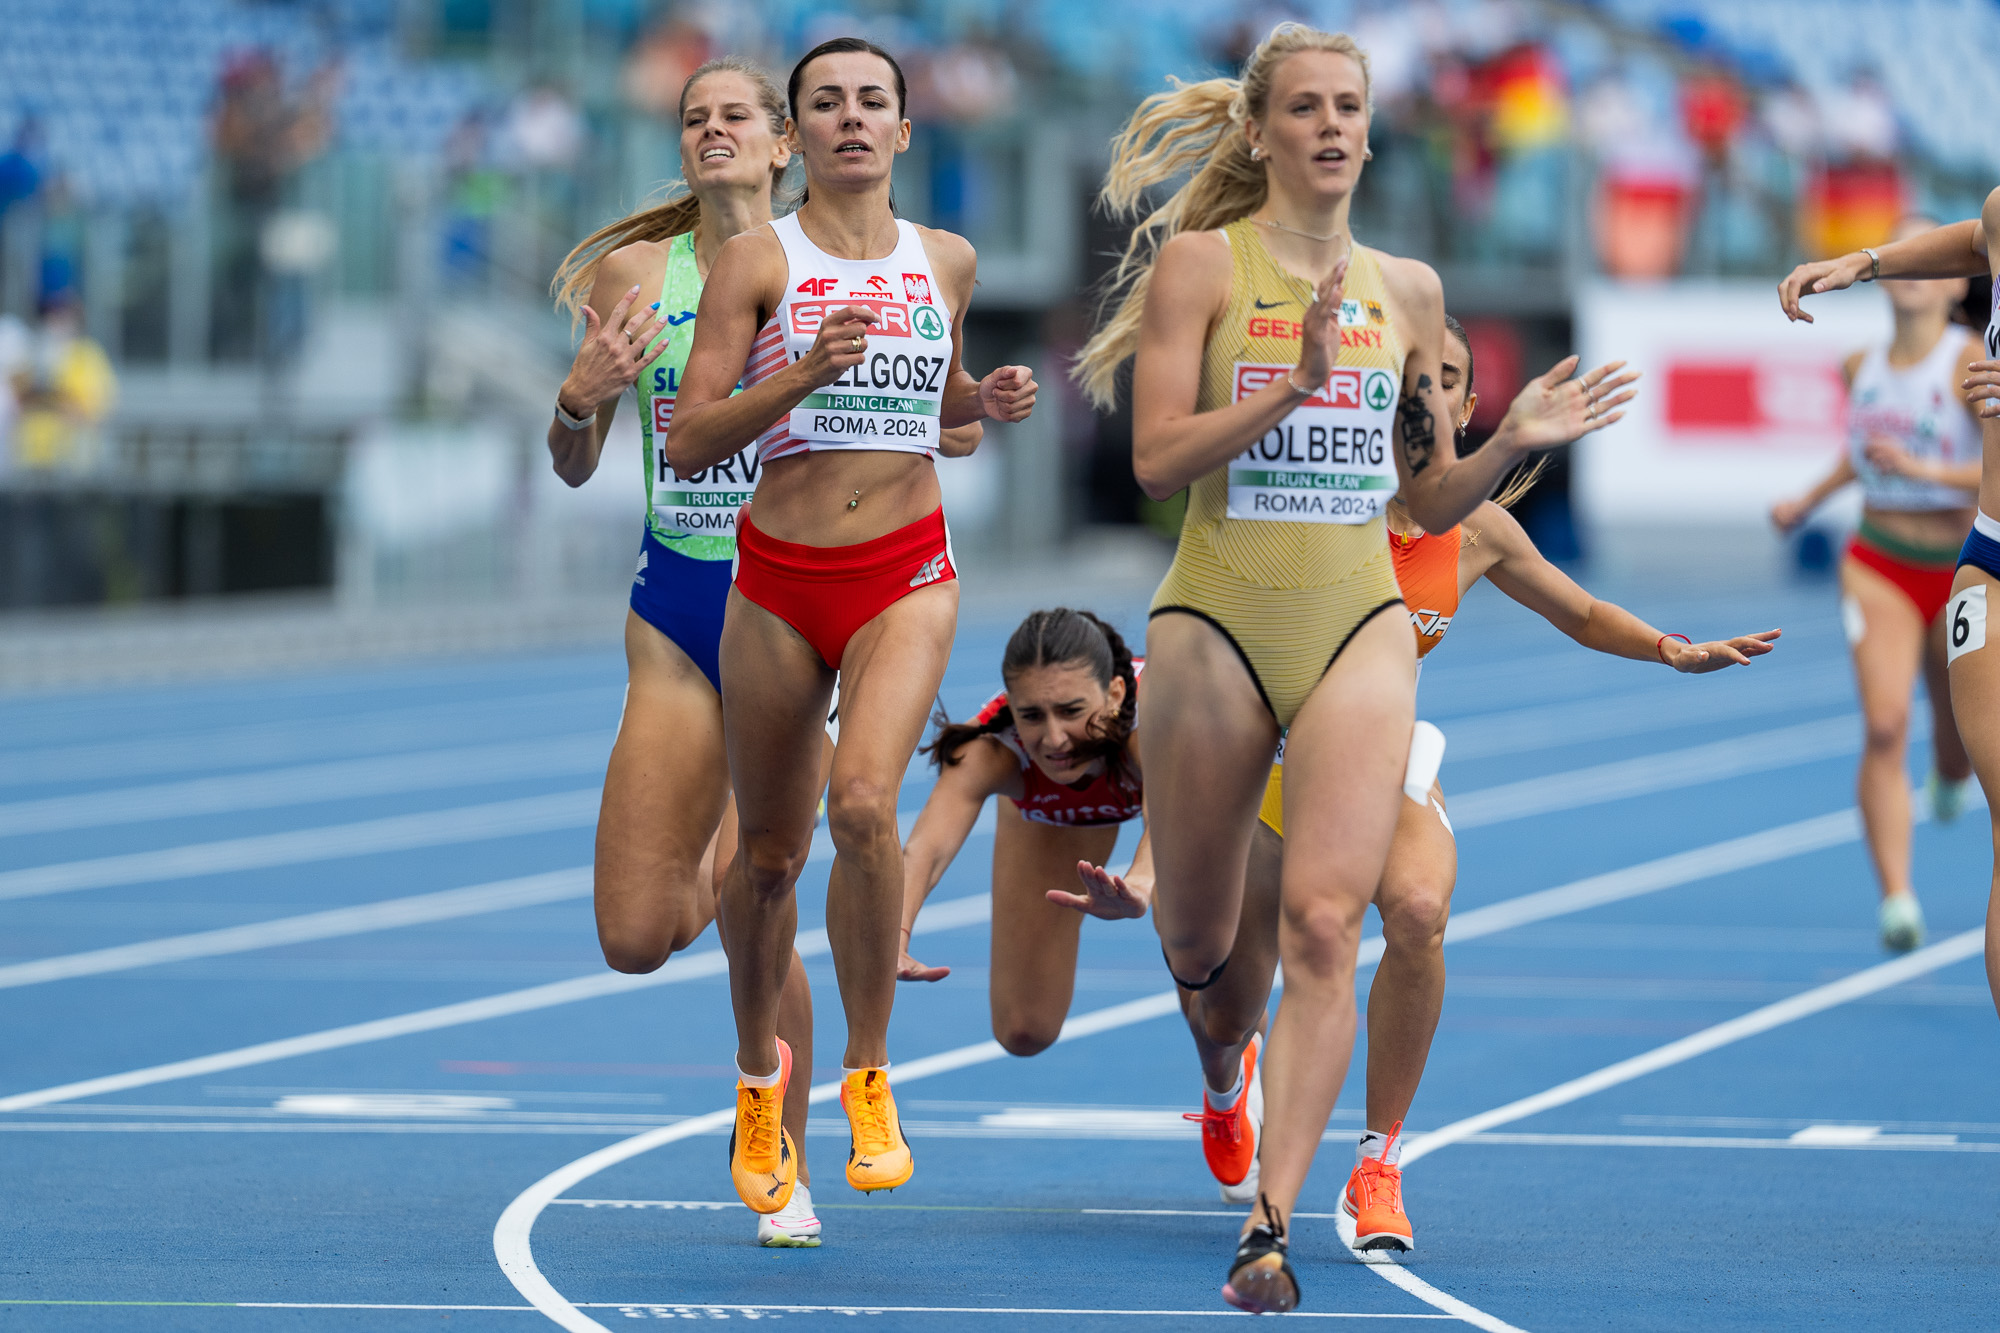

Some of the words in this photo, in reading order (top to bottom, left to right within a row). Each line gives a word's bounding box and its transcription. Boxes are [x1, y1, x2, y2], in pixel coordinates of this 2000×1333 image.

[797, 278, 838, 296] 4F
[1249, 318, 1382, 348] GERANY
[1240, 371, 1358, 404] SR
[827, 396, 831, 407] I
[834, 396, 866, 409] RUN
[814, 415, 878, 435] ROMA
[883, 419, 927, 438] 2024
[1238, 425, 1384, 465] OLBERG
[1267, 473, 1272, 485] I
[1276, 473, 1311, 487] RUN
[686, 493, 690, 504] I
[692, 494, 723, 505] RUN
[1254, 494, 1324, 513] ROMA
[1331, 497, 1378, 516] 2024
[676, 512, 736, 529] ROMA
[909, 550, 946, 588] 4F
[1952, 600, 1970, 648] 6
